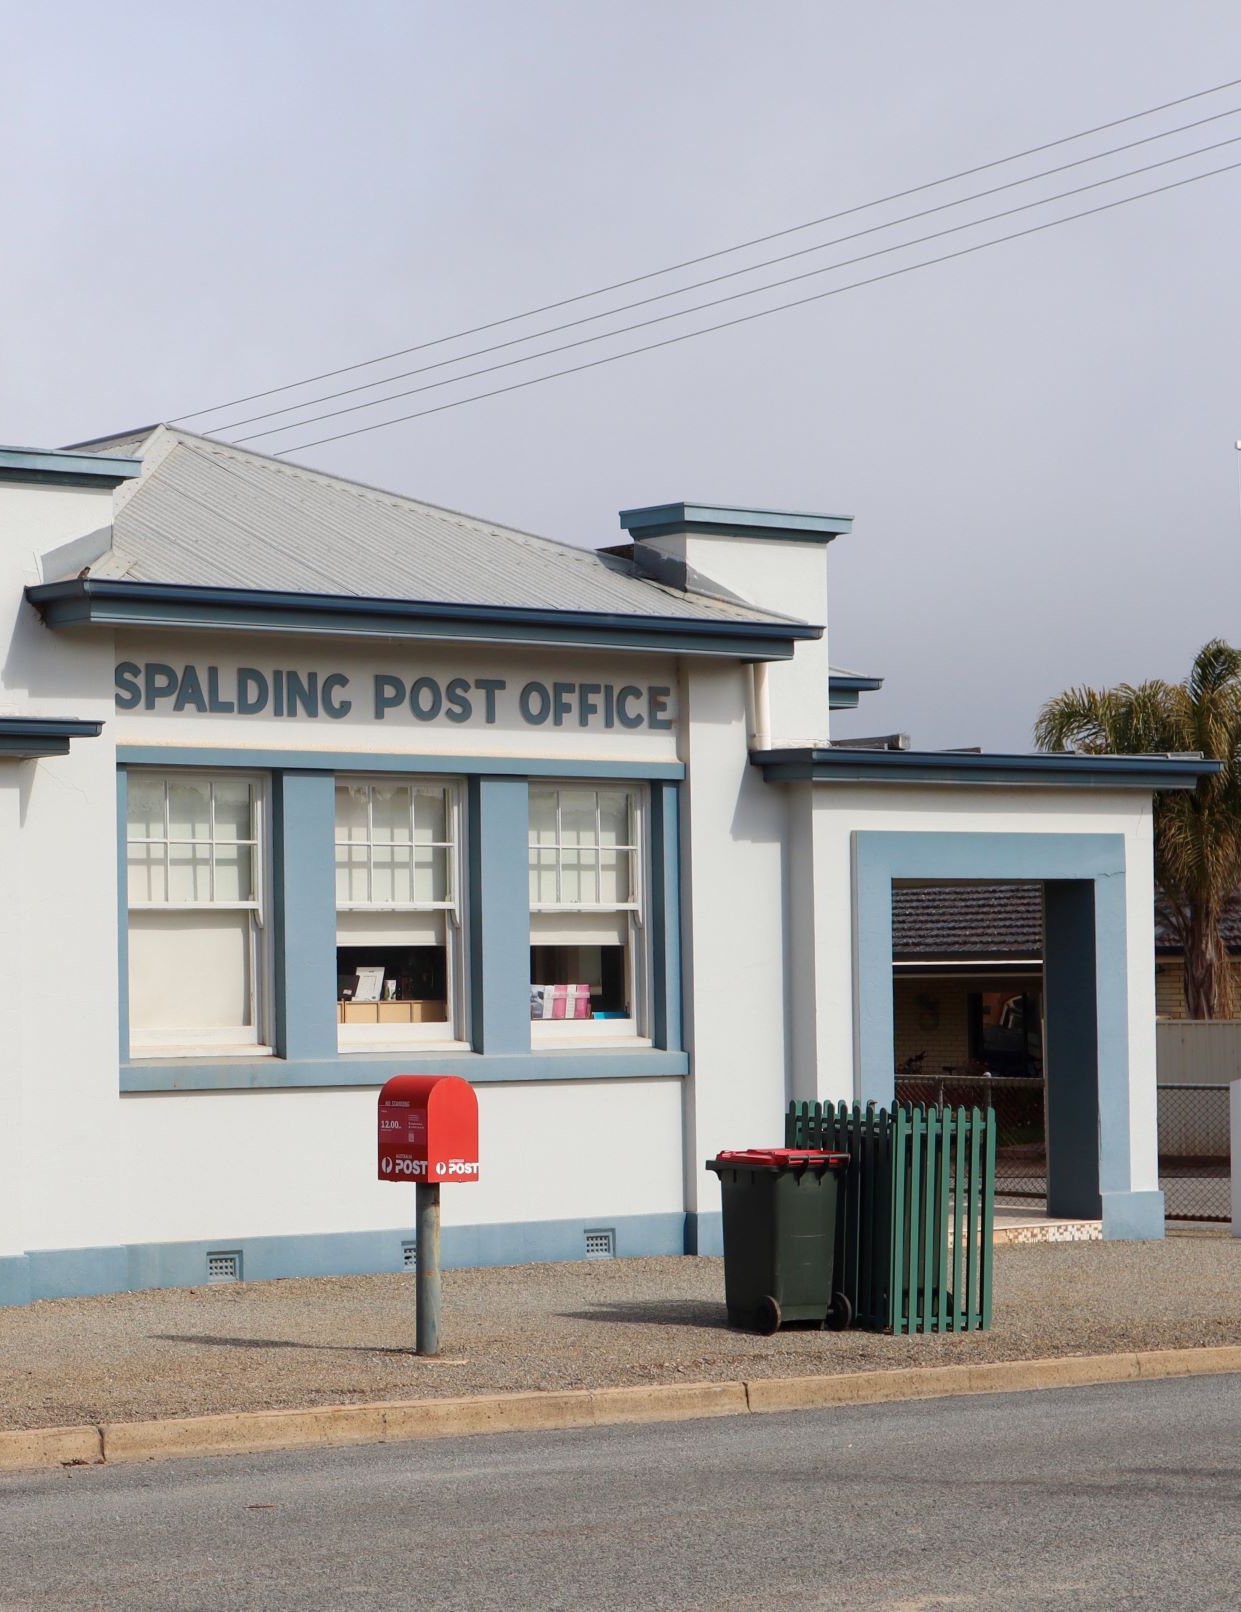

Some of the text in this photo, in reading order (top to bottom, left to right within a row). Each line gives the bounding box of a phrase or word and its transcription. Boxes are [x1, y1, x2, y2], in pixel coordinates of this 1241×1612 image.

[114, 662, 672, 729] SPALDING POST OFFICE
[395, 1160, 427, 1174] POST
[448, 1163, 479, 1174] POST
